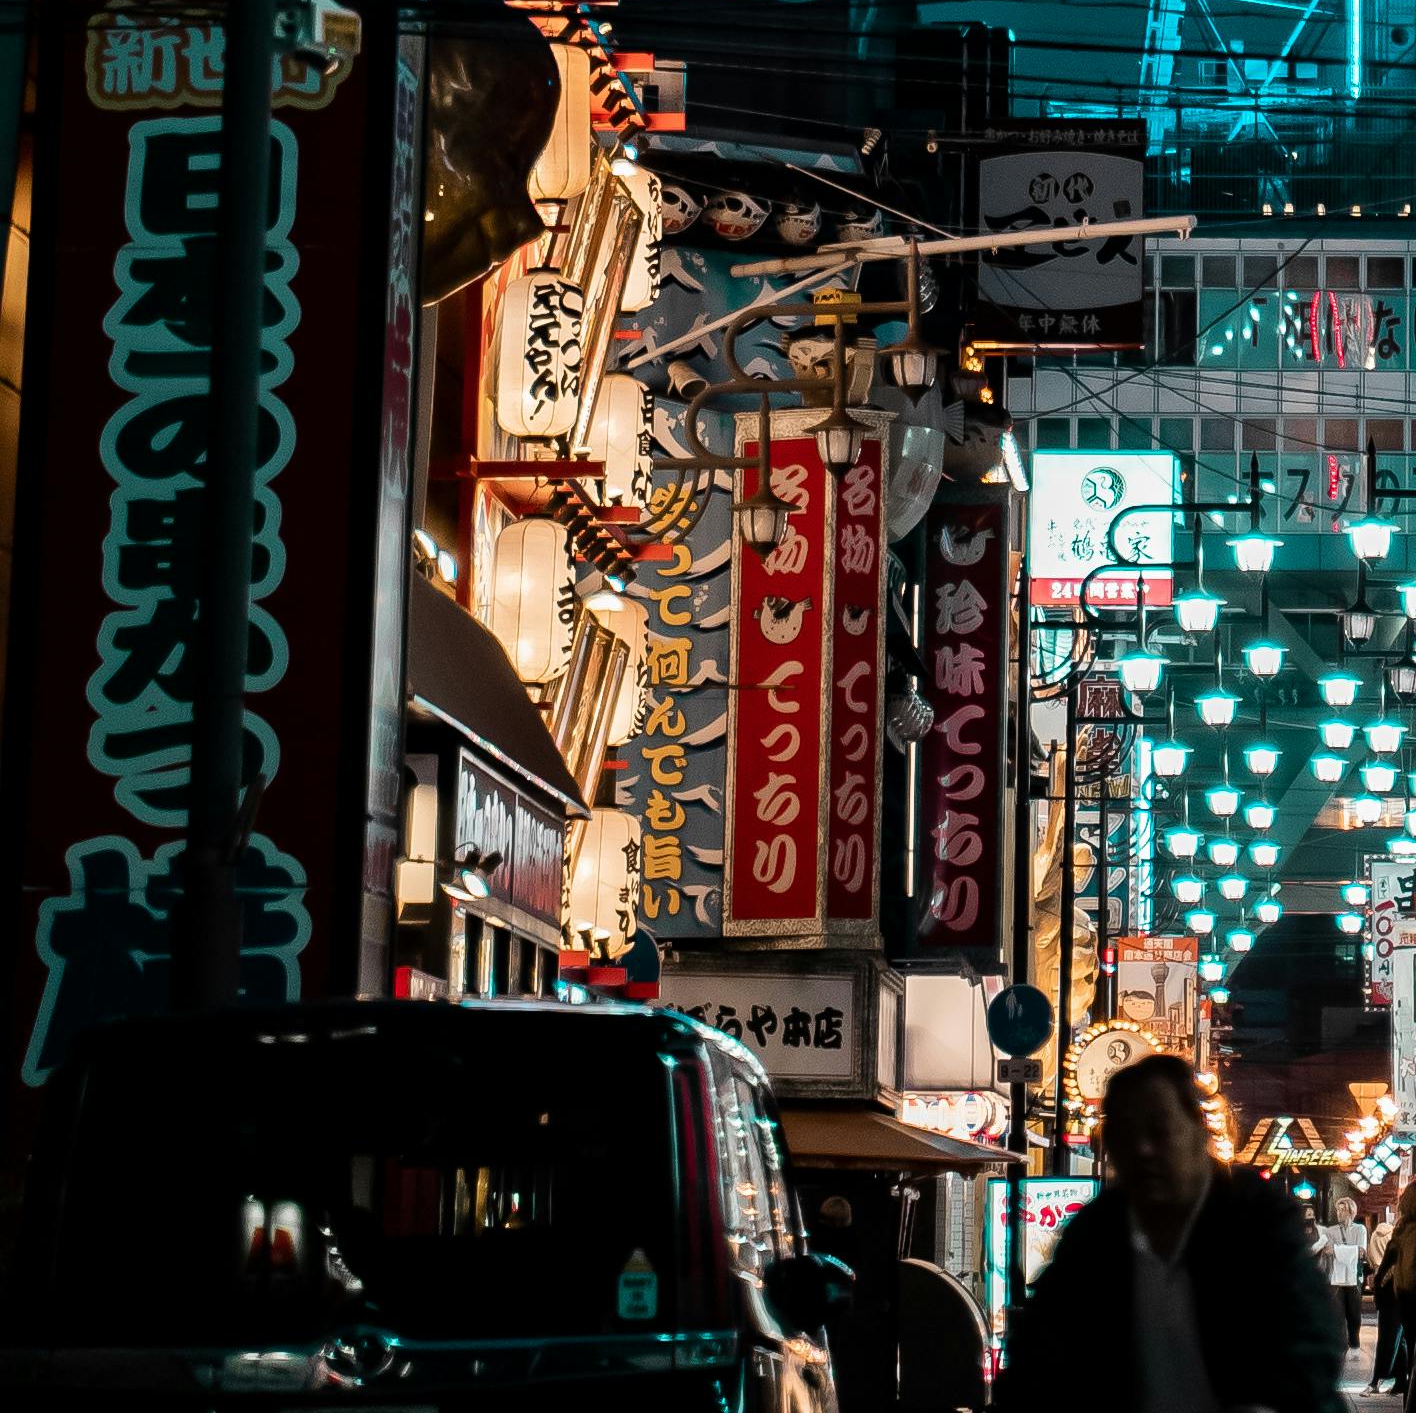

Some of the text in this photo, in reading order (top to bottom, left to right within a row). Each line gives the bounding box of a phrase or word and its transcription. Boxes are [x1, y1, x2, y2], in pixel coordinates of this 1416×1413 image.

[839, 463, 876, 577] 名物
[751, 659, 806, 895] てっちり
[832, 659, 873, 895] てっちり
[929, 578, 993, 935] 珍味てっちり
[667, 1002, 843, 1050] らや本店
